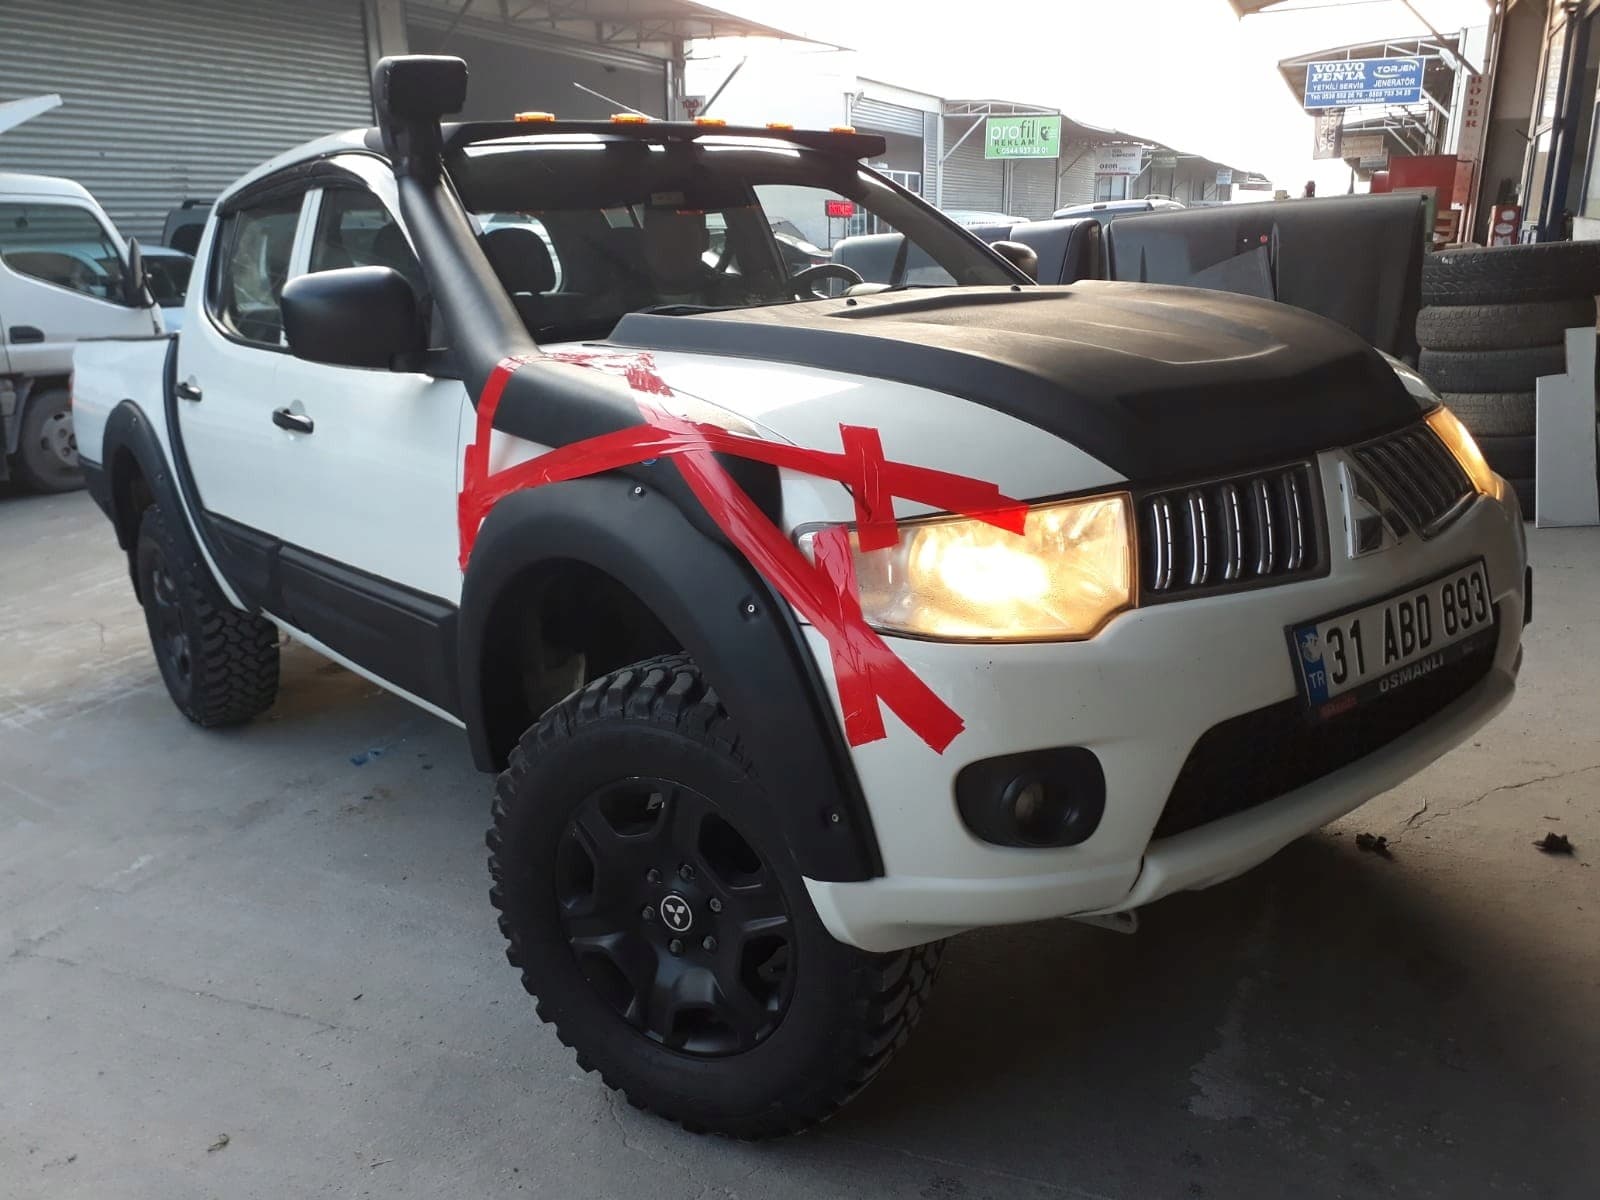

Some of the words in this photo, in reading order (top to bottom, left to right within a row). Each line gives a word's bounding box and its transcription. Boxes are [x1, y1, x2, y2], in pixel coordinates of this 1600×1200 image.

[1313, 62, 1365, 73] VOLVO
[1376, 65, 1416, 73] TORJEN
[1311, 71, 1366, 82] PENTA
[1373, 78, 1415, 87] JENERATÖR
[991, 120, 1035, 146] profil
[1326, 620, 1365, 685] 31
[1384, 594, 1432, 666] ABD
[1441, 571, 1487, 636] 893
[1309, 669, 1325, 689] TR
[1379, 653, 1444, 693] OSMANLI
